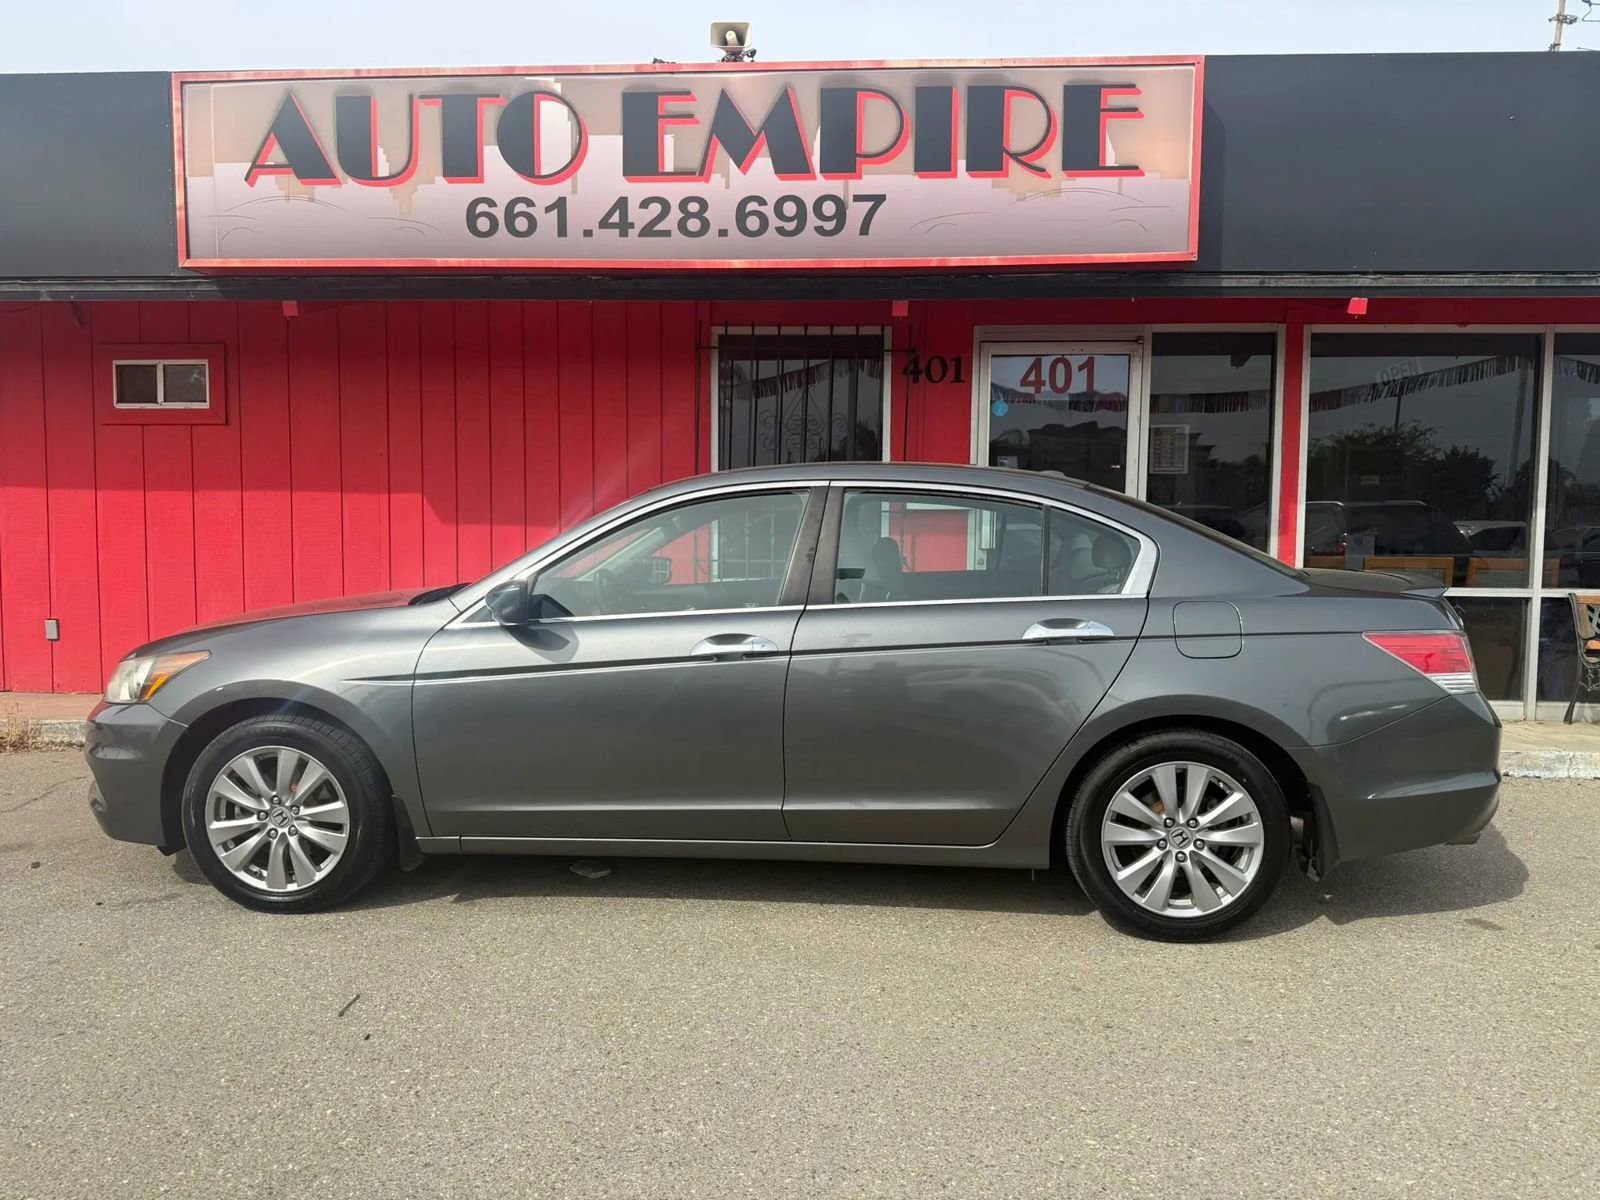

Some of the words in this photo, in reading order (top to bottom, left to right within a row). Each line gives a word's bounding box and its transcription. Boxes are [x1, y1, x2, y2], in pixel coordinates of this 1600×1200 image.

[245, 89, 588, 188] AUTO
[621, 82, 1145, 184] EMPIRE
[465, 193, 887, 238] 661.428.6997
[901, 355, 966, 384] 401
[1020, 356, 1095, 395] 401
